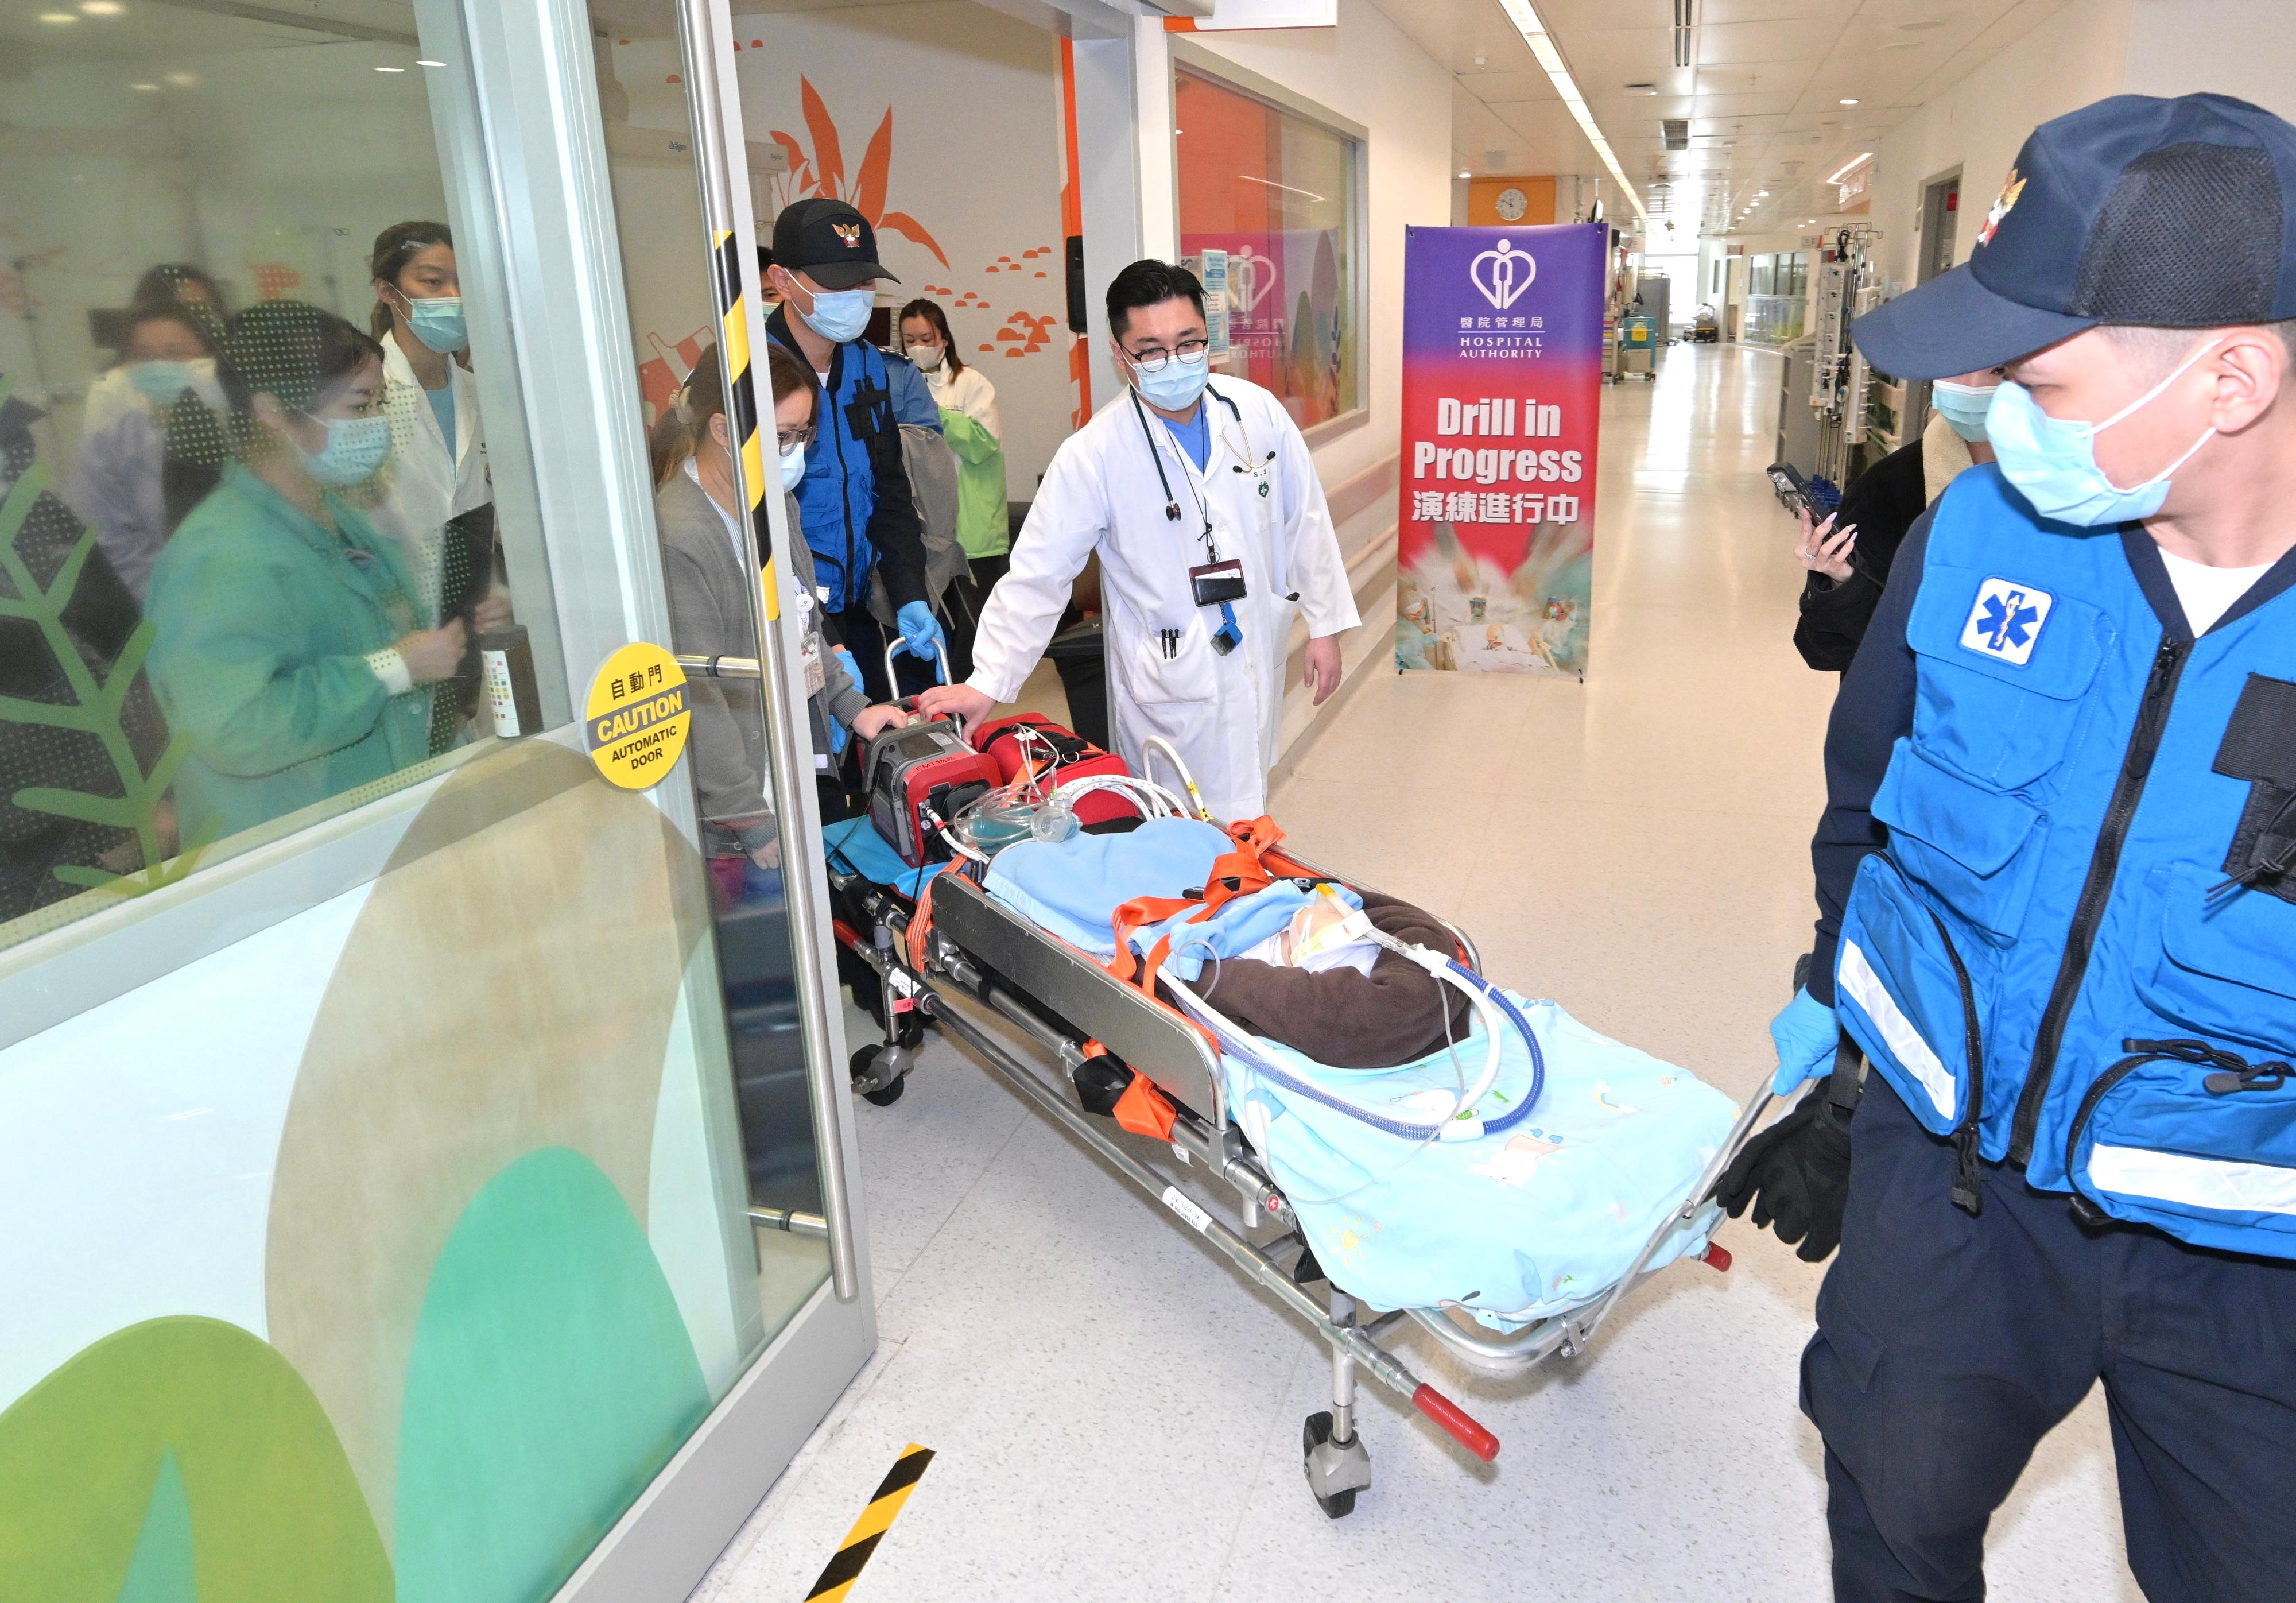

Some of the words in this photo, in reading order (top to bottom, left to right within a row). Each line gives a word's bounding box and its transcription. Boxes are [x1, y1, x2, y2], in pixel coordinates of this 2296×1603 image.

[1460, 317, 1543, 328] 醫院管理局
[1459, 349, 1543, 358] AUTHORITY
[1460, 337, 1542, 346] HOSPITAL
[1437, 398, 1515, 436] Drill
[1525, 399, 1561, 437] in
[1414, 441, 1583, 485] Progress
[1412, 491, 1579, 525] 演練進行中
[611, 664, 662, 700] 自動門
[598, 691, 682, 742] CAUTION
[612, 725, 677, 762] AUTOMATIC
[631, 747, 664, 770] DOOR
